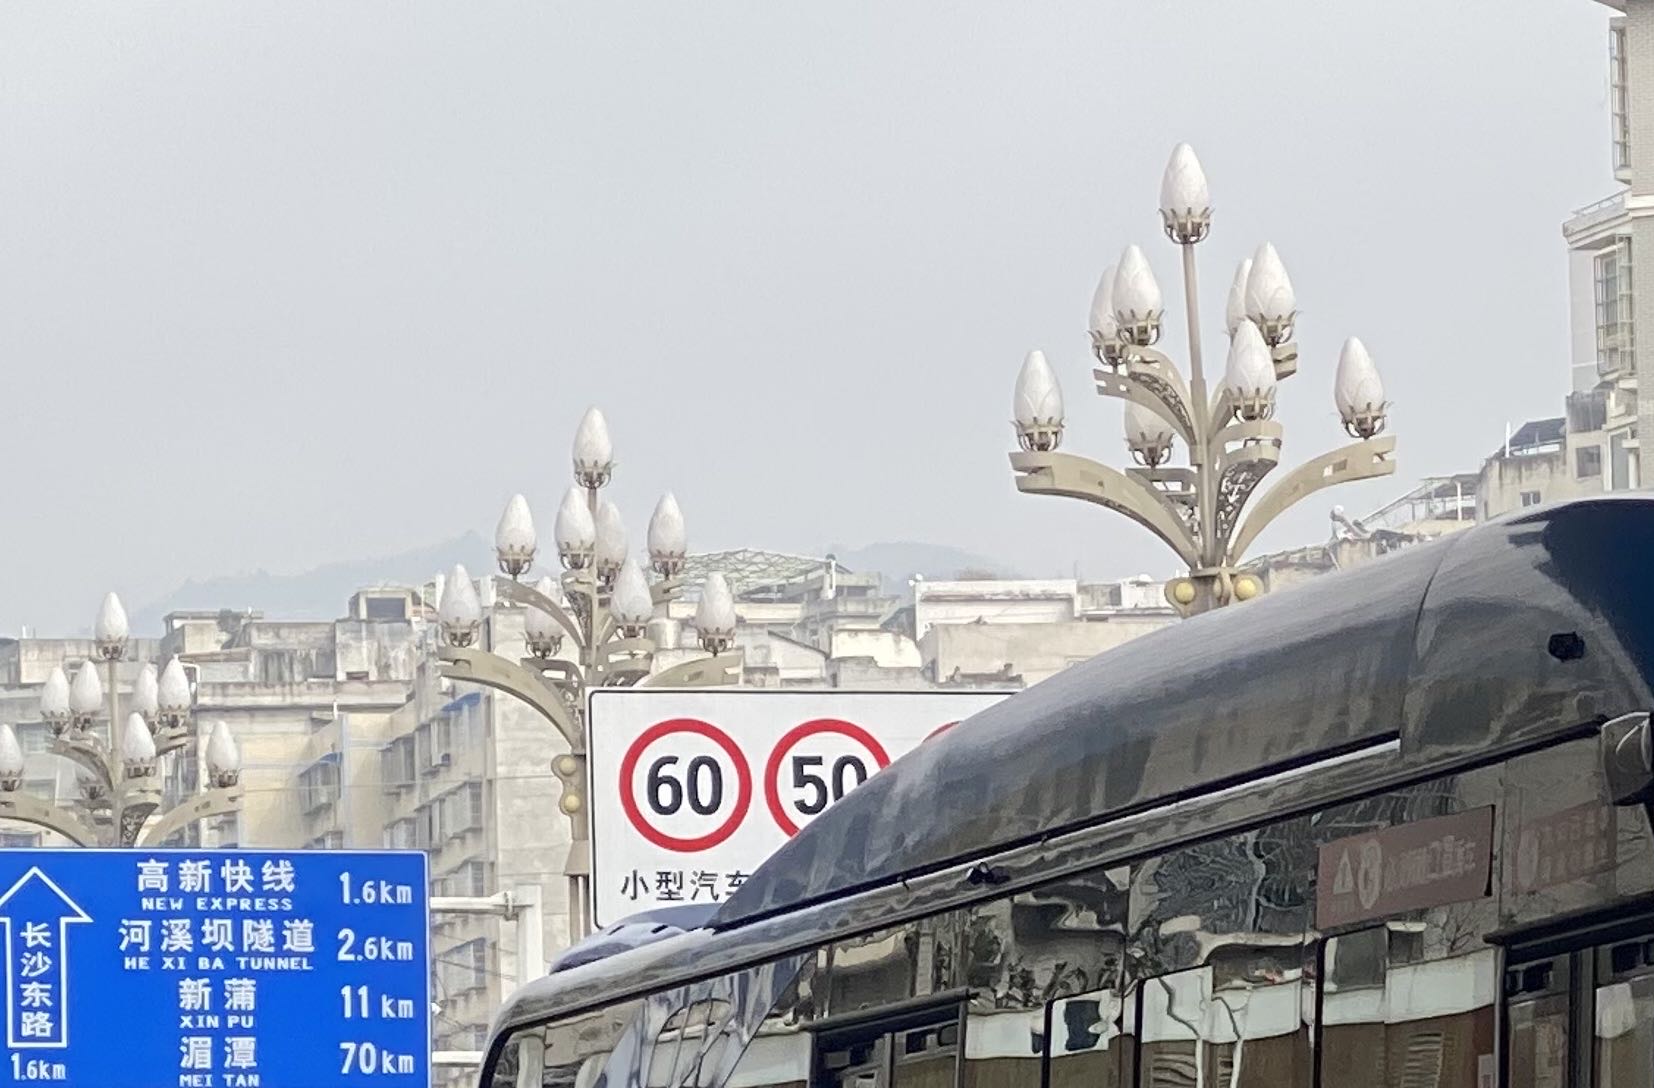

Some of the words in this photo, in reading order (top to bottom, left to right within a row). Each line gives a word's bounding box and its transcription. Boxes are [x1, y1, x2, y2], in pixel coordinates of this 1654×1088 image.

[646, 755, 723, 817] 60
[791, 755, 868, 816] 50
[136, 858, 295, 893] 高新快线
[339, 871, 412, 904] 1.6km
[141, 897, 183, 911] NEW
[196, 897, 292, 911] EXPRESS
[118, 918, 315, 953] 河溪坝隧道
[337, 928, 413, 961] 2.6km
[20, 921, 54, 1038] 长沙东路
[124, 956, 148, 970] HE
[162, 956, 186, 970] XI
[198, 956, 225, 970] BA
[236, 956, 312, 970] TUNNEL
[179, 977, 257, 1011] 新蒲
[180, 1015, 219, 1029] XIN
[227, 1015, 254, 1029] PU
[11, 1052, 66, 1080] 1.6km
[179, 1036, 257, 1070] 湄潭
[179, 1074, 212, 1088] MEI
[223, 1074, 259, 1087] TAN
